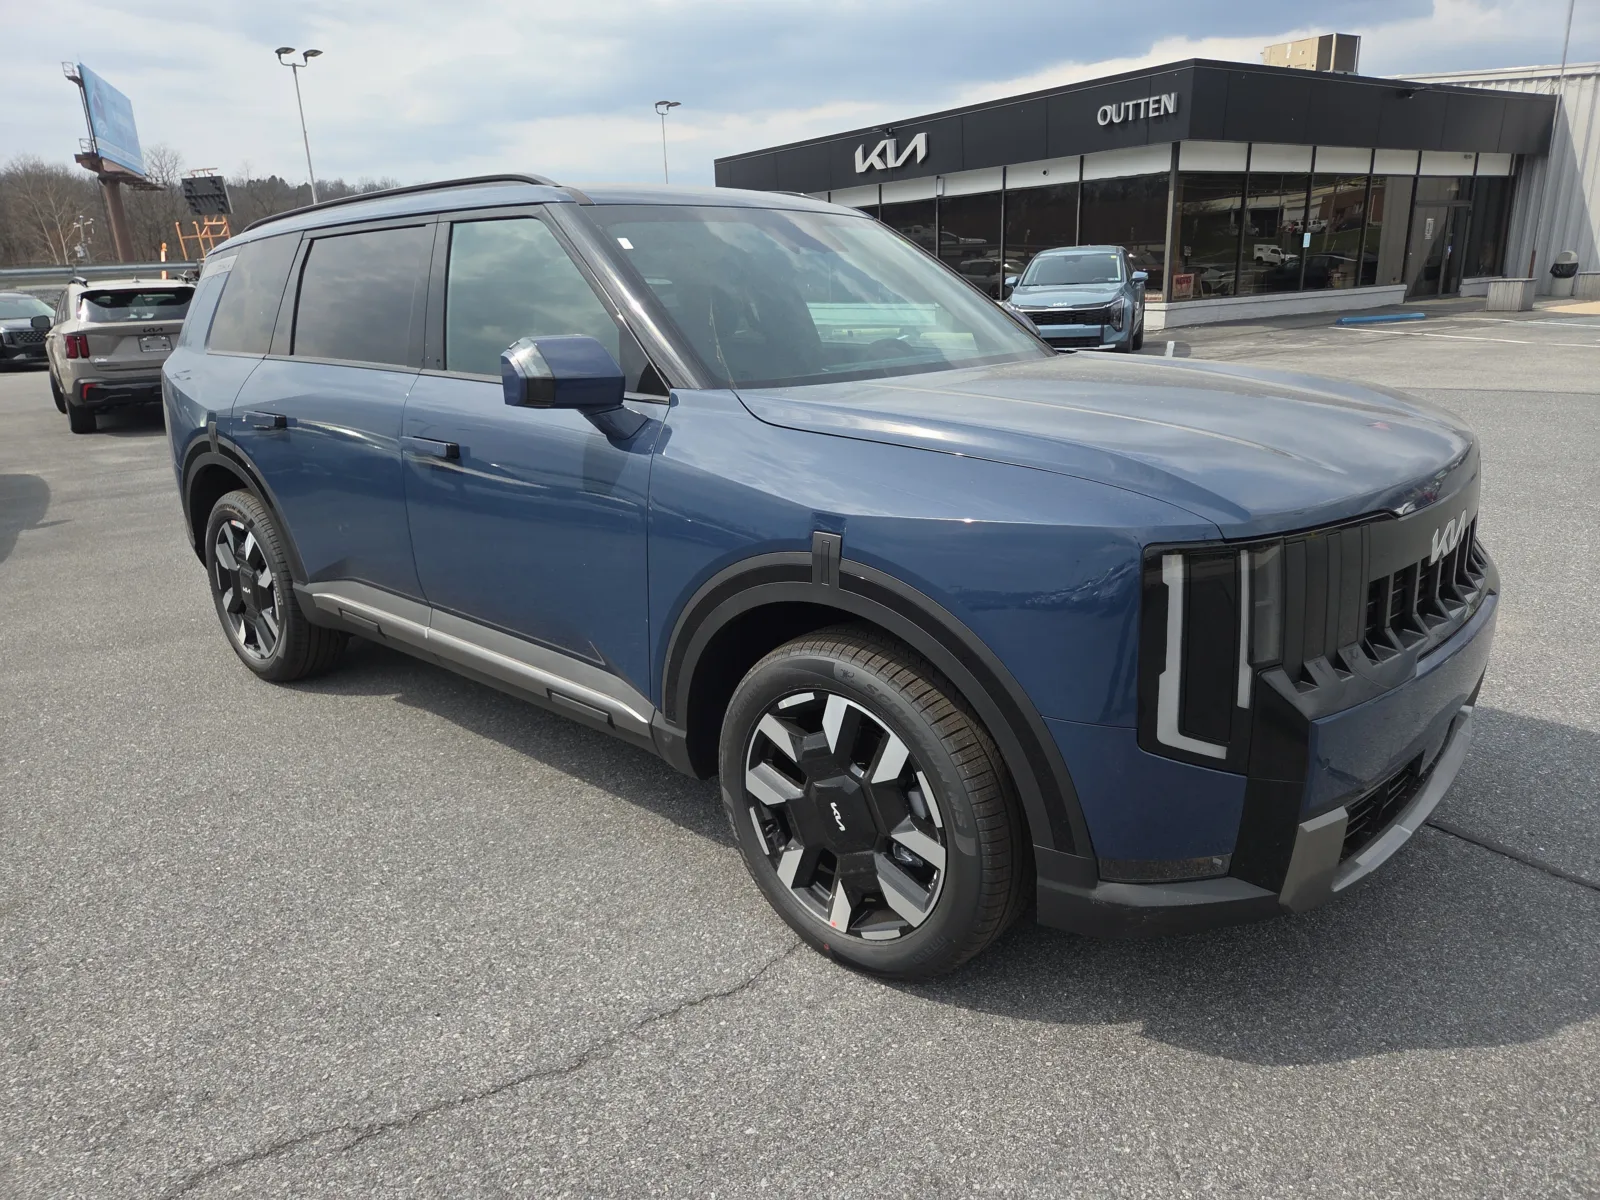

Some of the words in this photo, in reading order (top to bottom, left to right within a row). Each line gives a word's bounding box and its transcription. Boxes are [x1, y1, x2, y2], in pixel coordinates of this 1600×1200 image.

[1097, 92, 1178, 126] OUTTEN
[854, 132, 928, 173] KIA
[1430, 509, 1467, 562] KIA
[830, 802, 846, 831] KIA
